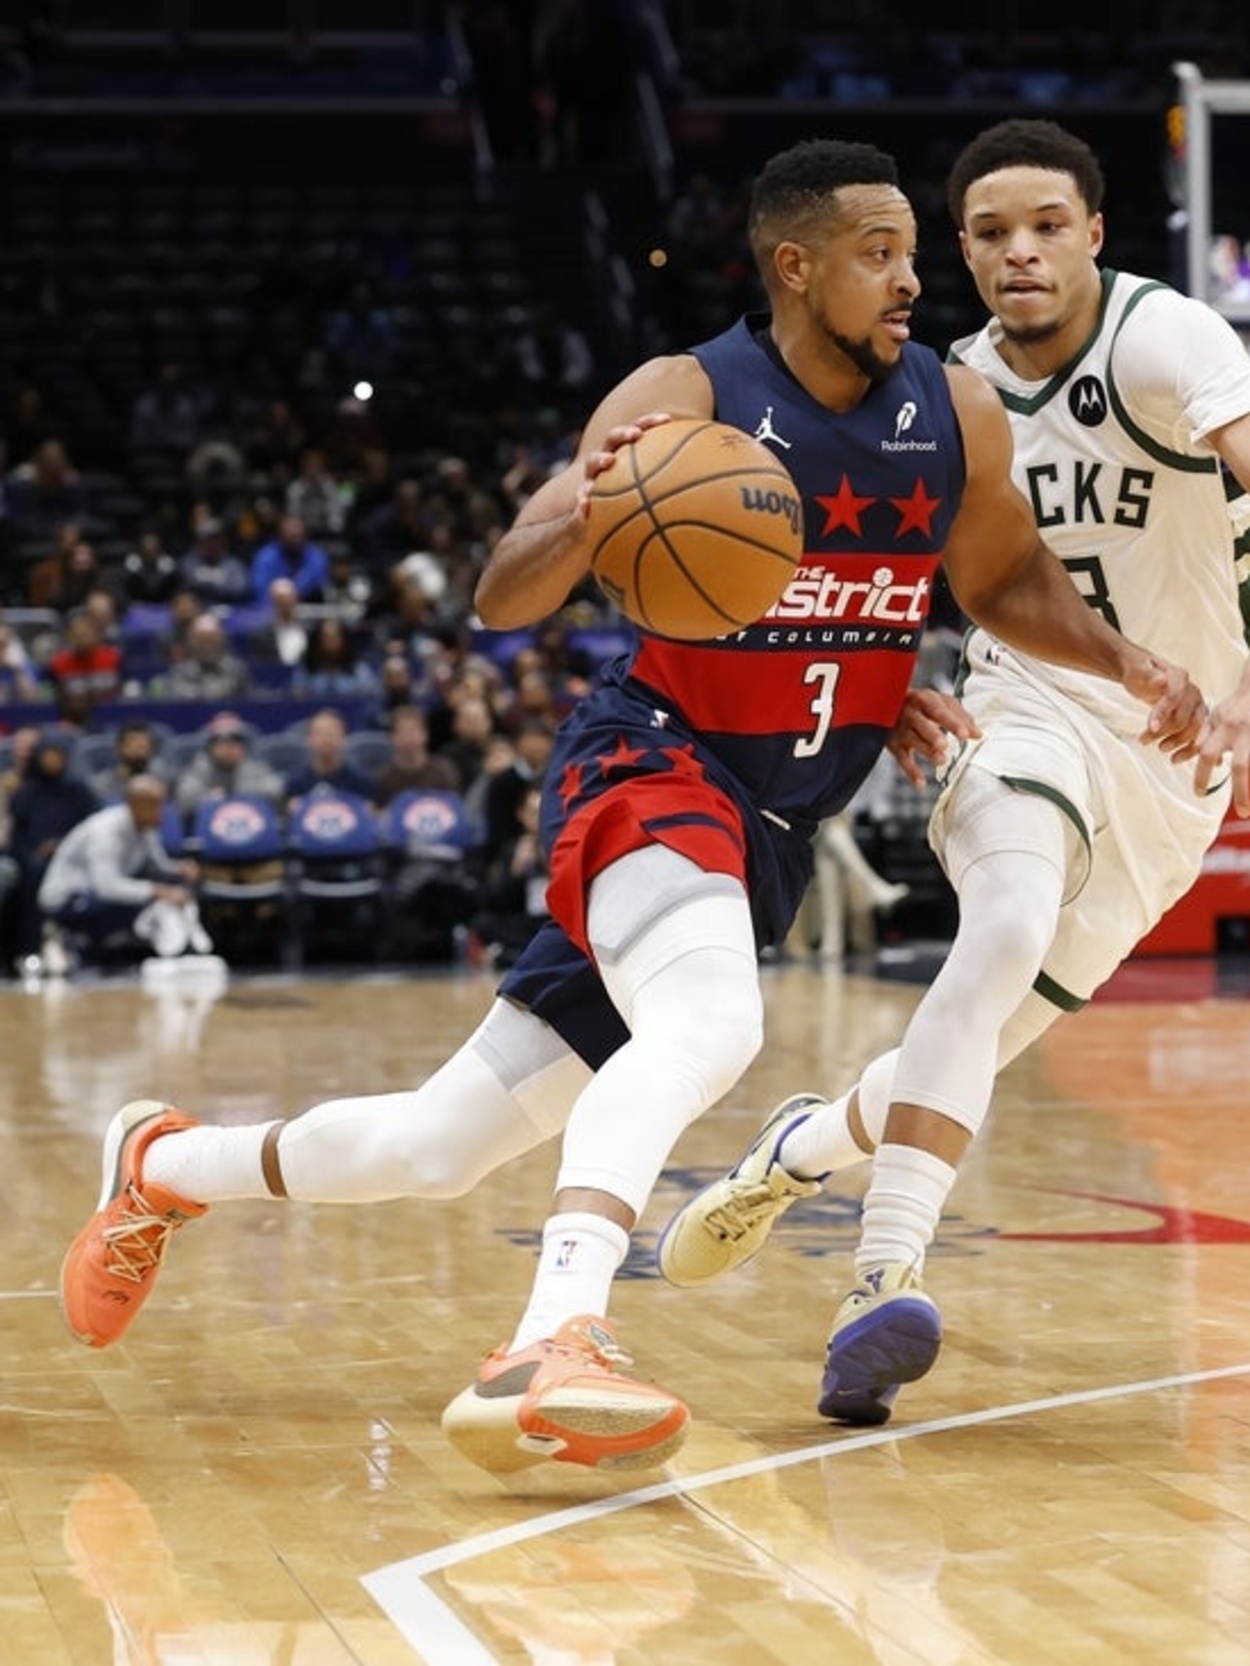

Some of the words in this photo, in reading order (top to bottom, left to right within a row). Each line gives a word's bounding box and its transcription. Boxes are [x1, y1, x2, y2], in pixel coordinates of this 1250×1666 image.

[881, 440, 937, 451] Robinhood
[1026, 460, 1155, 528] CKS
[765, 567, 928, 621] strict
[793, 663, 840, 758] 3
